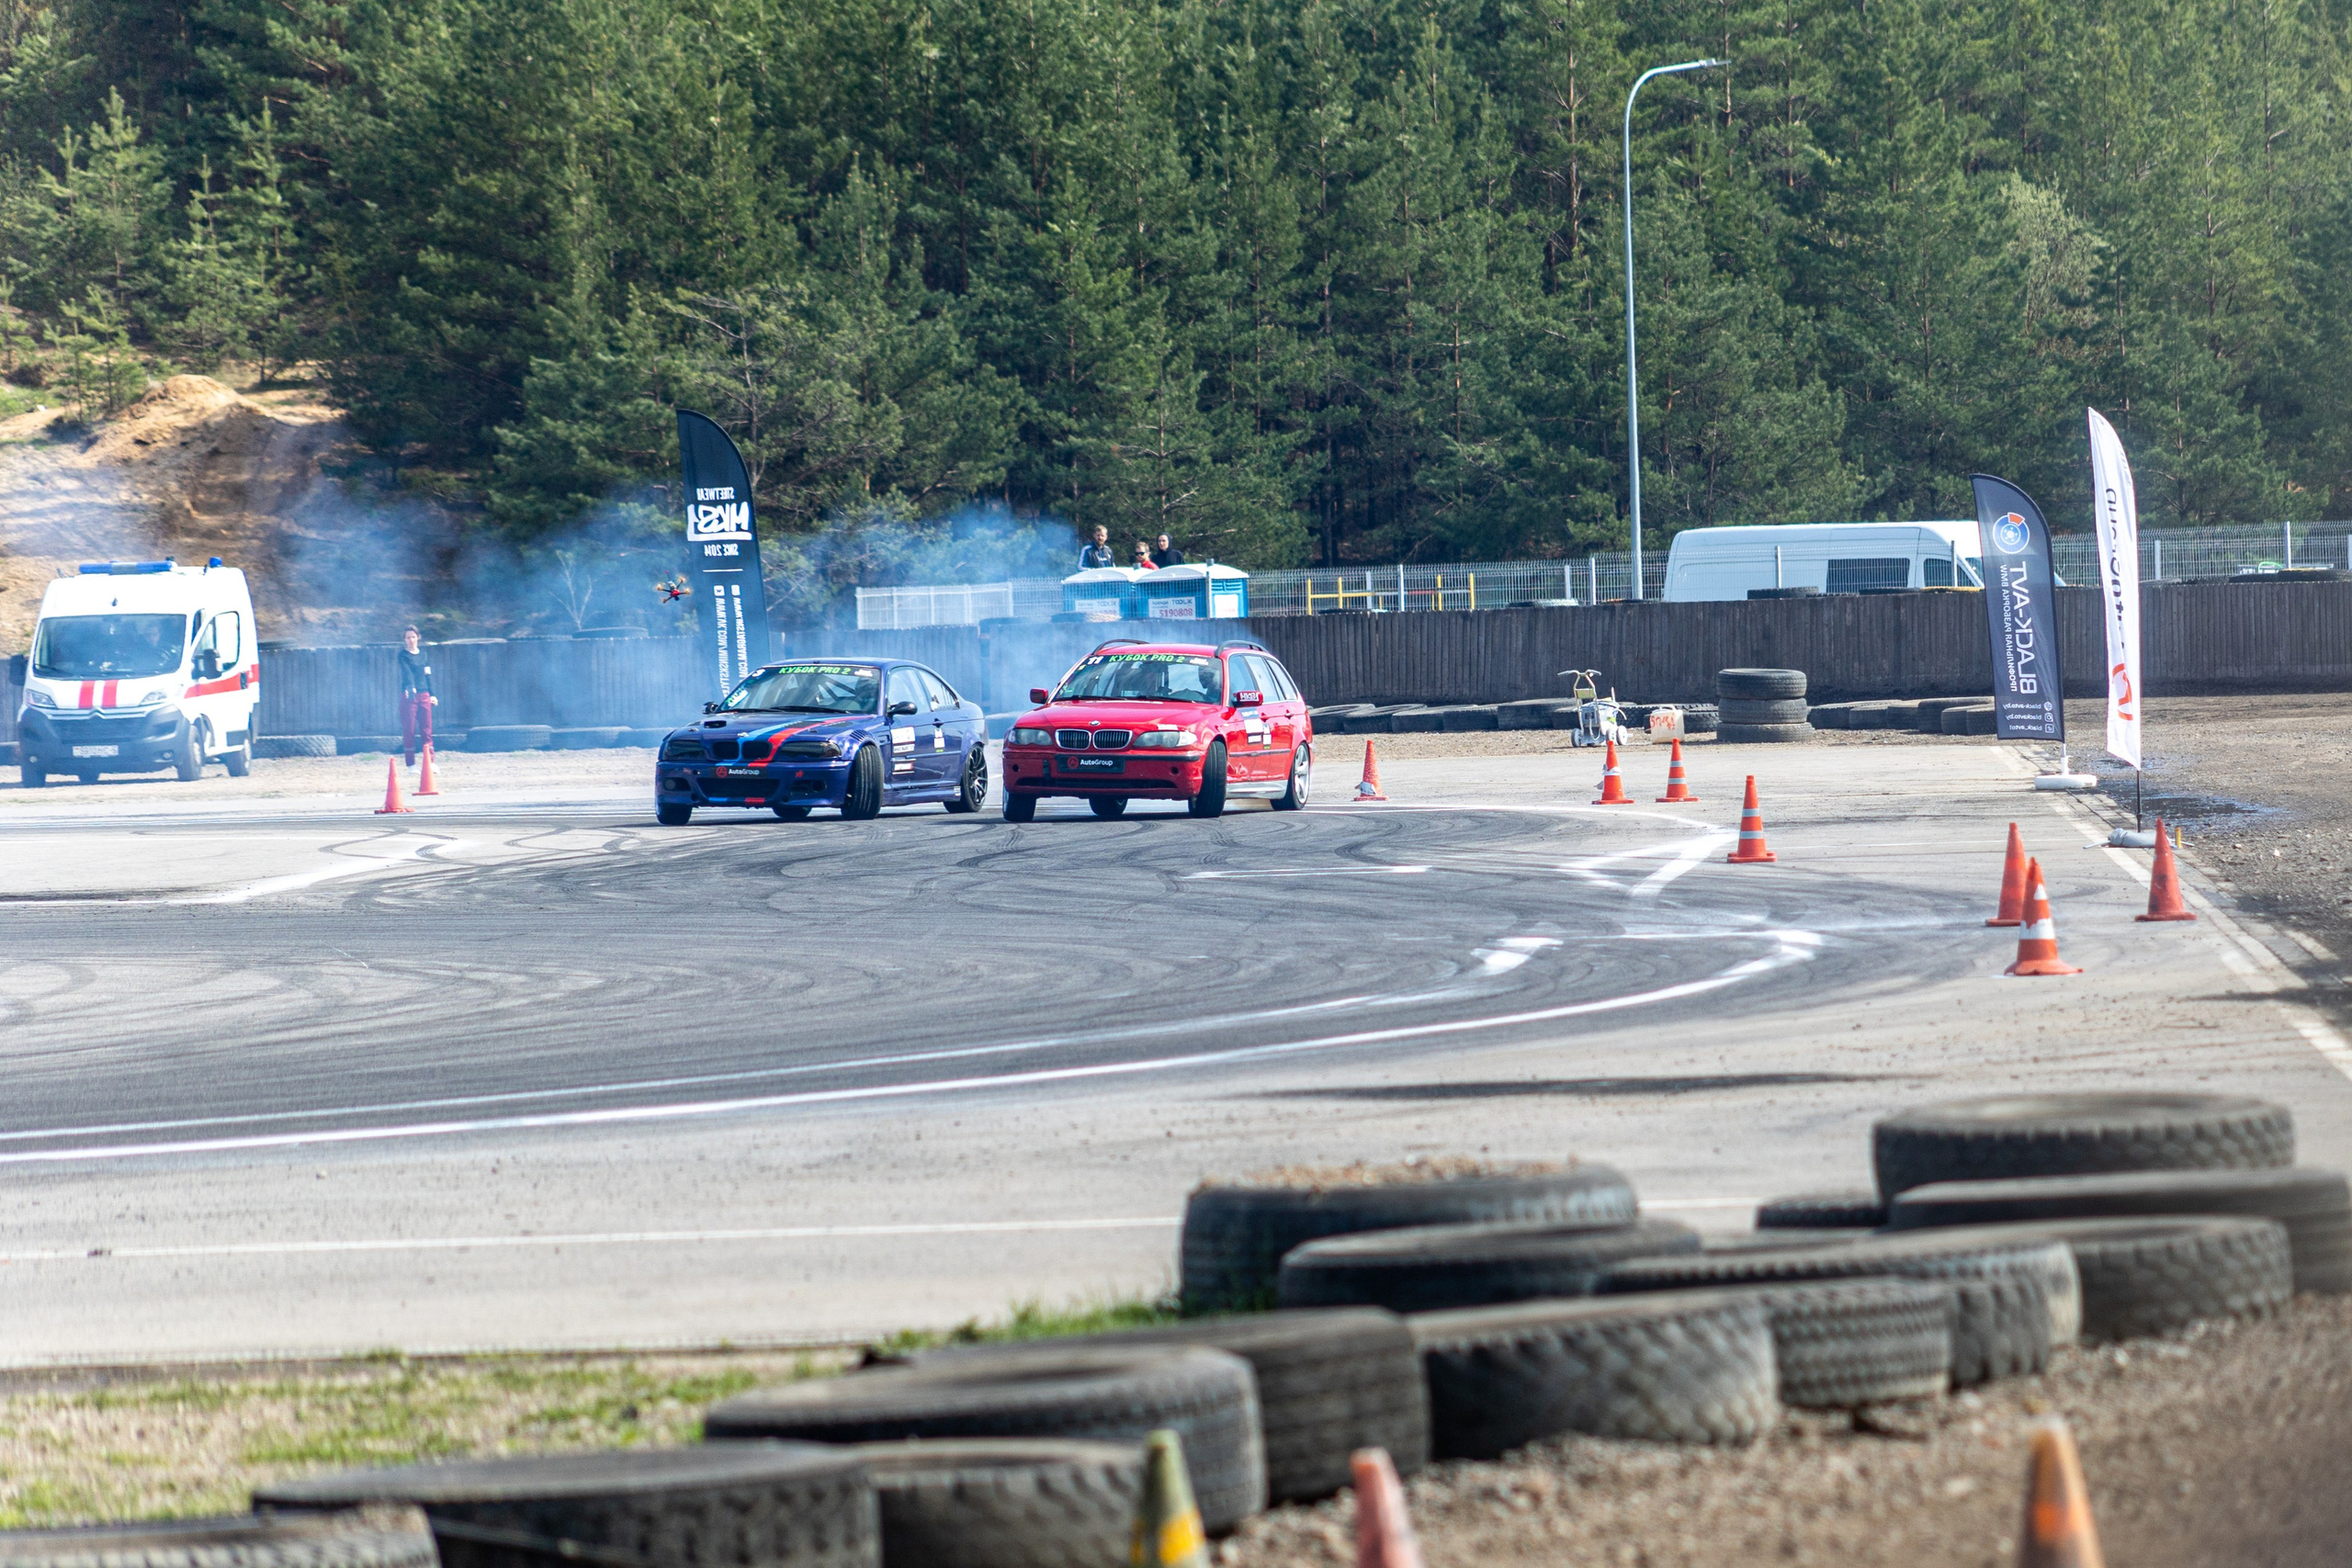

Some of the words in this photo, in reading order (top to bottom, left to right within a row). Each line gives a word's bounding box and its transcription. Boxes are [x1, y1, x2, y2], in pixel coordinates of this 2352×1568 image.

[1159, 608, 1193, 618] 5190808
[1109, 654, 1148, 662] КУБОК
[1150, 654, 1174, 662] PRO
[778, 666, 817, 674] КУБОК
[818, 666, 841, 675] PRO
